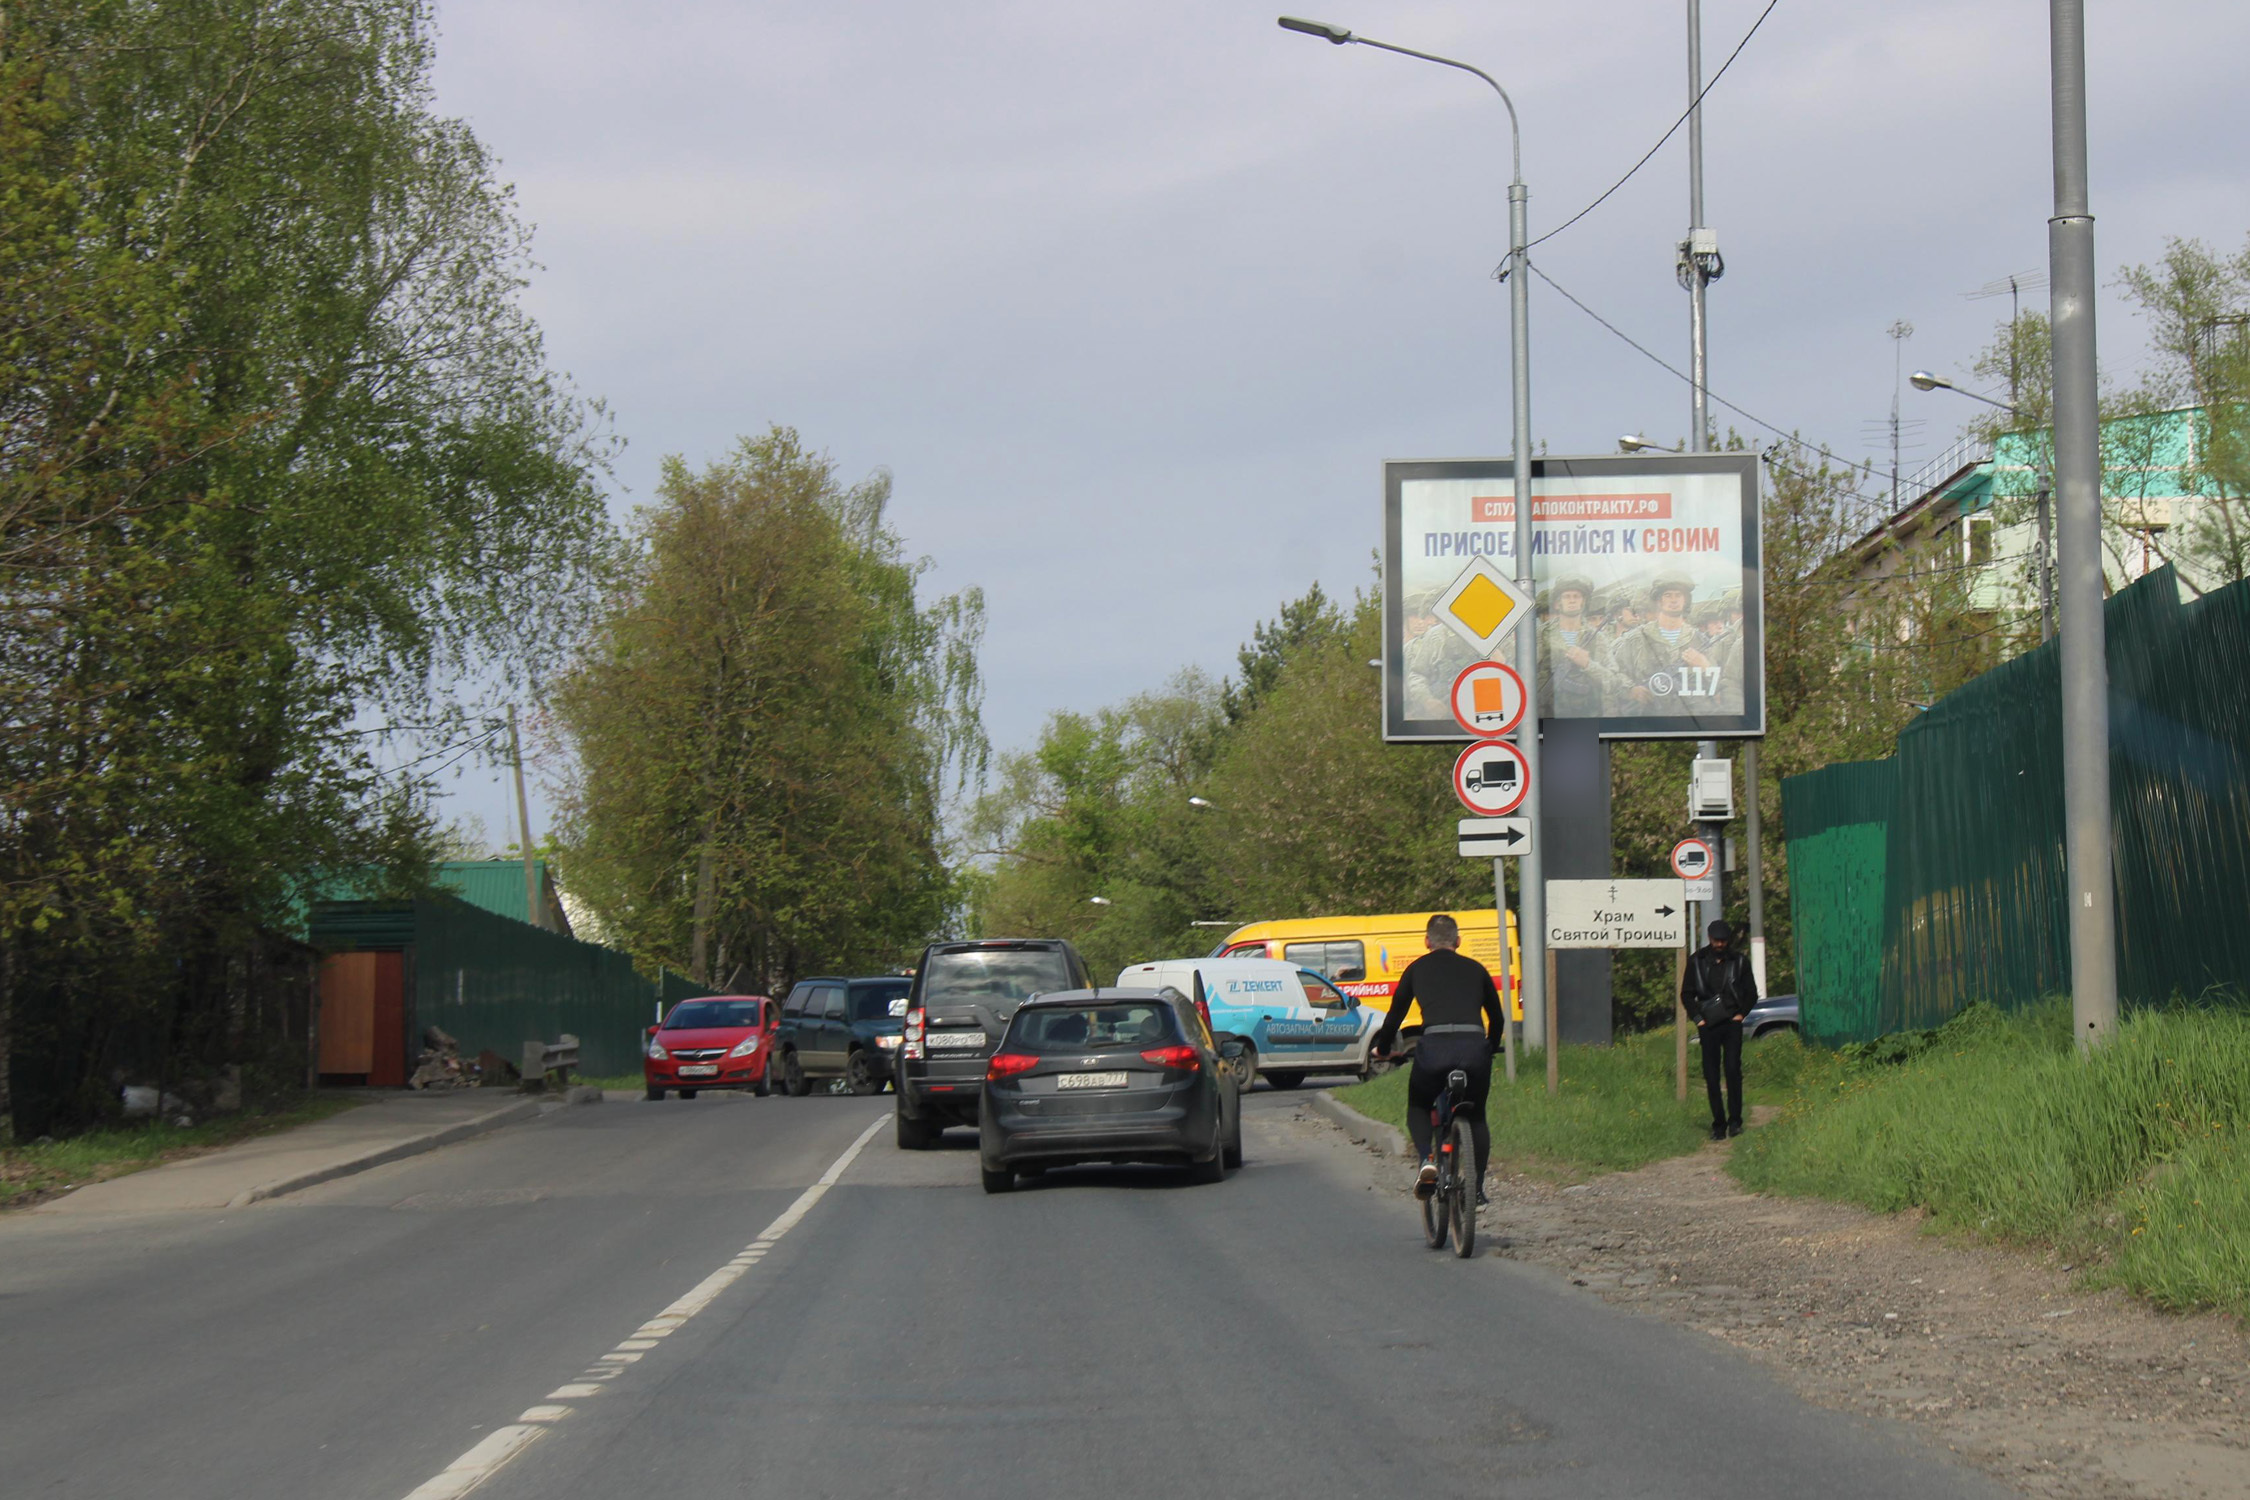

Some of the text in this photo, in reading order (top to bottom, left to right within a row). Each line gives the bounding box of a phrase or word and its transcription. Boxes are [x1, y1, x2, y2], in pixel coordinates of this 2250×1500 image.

[1484, 499, 1659, 517] СЛУАПОКОНТРАКТУ.РФ
[1622, 528, 1637, 553] К
[1642, 527, 1719, 553] СВОИМ
[1678, 666, 1721, 696] 117
[1593, 909, 1634, 925] Храм
[1551, 927, 1677, 943] Святой Троицы
[1320, 983, 1389, 998] АВРИЙНАЯ
[1266, 1023, 1324, 1035] АВТОЗАПЧАСТИ
